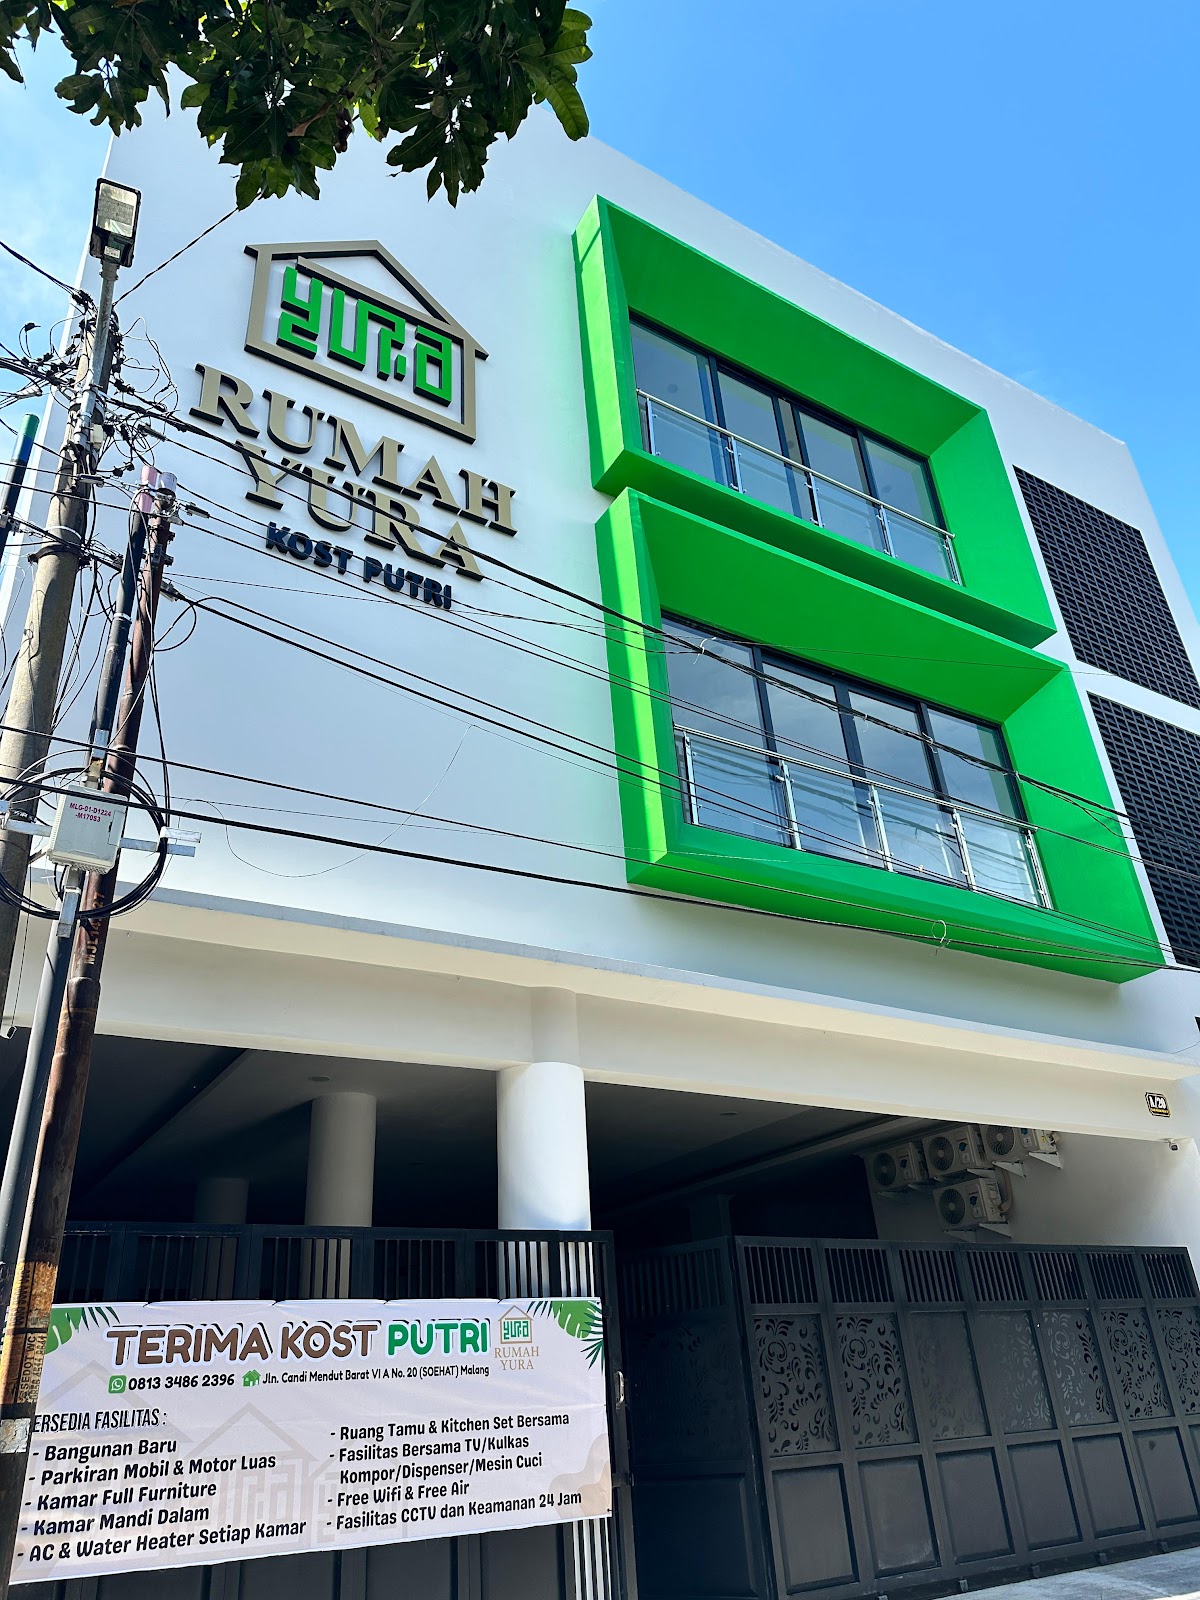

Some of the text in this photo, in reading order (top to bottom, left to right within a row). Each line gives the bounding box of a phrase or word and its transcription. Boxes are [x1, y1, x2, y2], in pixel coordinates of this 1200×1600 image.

[189, 363, 518, 537] RUMAH
[234, 440, 486, 581] YURA
[266, 521, 452, 610] KOST PUTRI
[107, 1321, 488, 1365] TERIMA KOST PUTRI
[494, 1346, 539, 1358] RUMAH
[20, 1336, 36, 1390] SEDOT WC
[263, 1365, 489, 1384] Jln. Candi Mendut Barat VI A No. 20 (SOEHAT) Malang
[500, 1359, 534, 1370] YURA
[129, 1374, 234, 1390] 0813 3486 2396
[32, 1412, 90, 1433] ERSEDIA
[95, 1409, 159, 1429] FASILITAS
[341, 1427, 384, 1442] Ruang
[388, 1424, 424, 1436] Tamu
[429, 1421, 437, 1433] &
[442, 1418, 489, 1433] Kitchen
[494, 1416, 513, 1429] Set
[518, 1415, 569, 1427] Bersama
[45, 1444, 132, 1463] Bangunan
[139, 1440, 176, 1454] Baru
[340, 1444, 398, 1462] Fasilitas
[403, 1442, 460, 1457] Bersama
[517, 1452, 541, 1468] Cuci
[41, 1465, 118, 1485] Parkiran
[124, 1460, 169, 1479] Mobil
[173, 1461, 183, 1475] &
[189, 1458, 237, 1474] Motor
[241, 1456, 275, 1470] Luas
[37, 1494, 98, 1510] Kamar
[103, 1488, 133, 1505] Full
[139, 1482, 216, 1502] Furniture
[338, 1493, 368, 1506] Free
[374, 1486, 401, 1503] Wifi
[405, 1486, 413, 1500] &
[418, 1485, 447, 1499] Free
[452, 1480, 469, 1495] Air
[34, 1519, 95, 1535] Kamar
[100, 1508, 153, 1530] Mandi
[158, 1507, 209, 1524] Dalam
[337, 1510, 396, 1529] Fasilitas
[402, 1506, 436, 1522] CCTV
[441, 1504, 464, 1518] dan
[469, 1498, 535, 1515] Keamanan
[540, 1494, 554, 1507] 24
[558, 1493, 581, 1506] Jam
[30, 1544, 54, 1561] AC
[59, 1543, 70, 1558] &
[77, 1539, 131, 1557] Water
[136, 1532, 194, 1551] Heater
[199, 1525, 250, 1544] Setiap
[256, 1522, 306, 1538] Kamar
